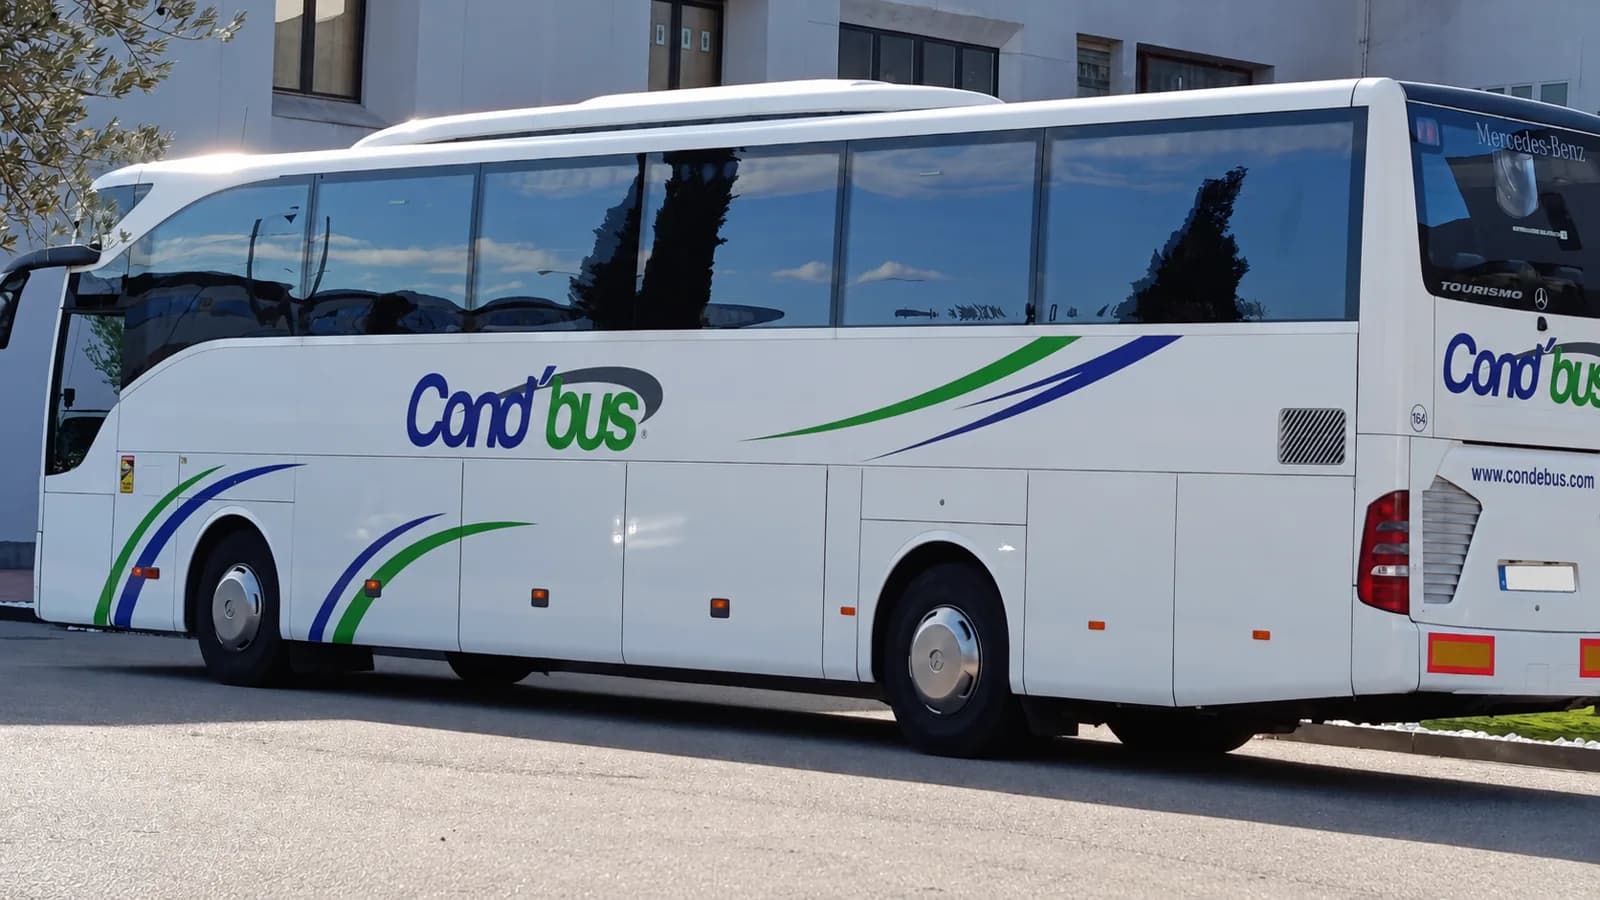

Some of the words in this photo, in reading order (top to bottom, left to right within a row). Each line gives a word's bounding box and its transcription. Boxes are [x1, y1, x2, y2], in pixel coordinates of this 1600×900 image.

[1476, 121, 1586, 163] Mercedes-Benz
[1440, 281, 1523, 299] TOURISMO
[1412, 412, 1426, 425] 164
[1471, 466, 1595, 489] www.condebus.com
